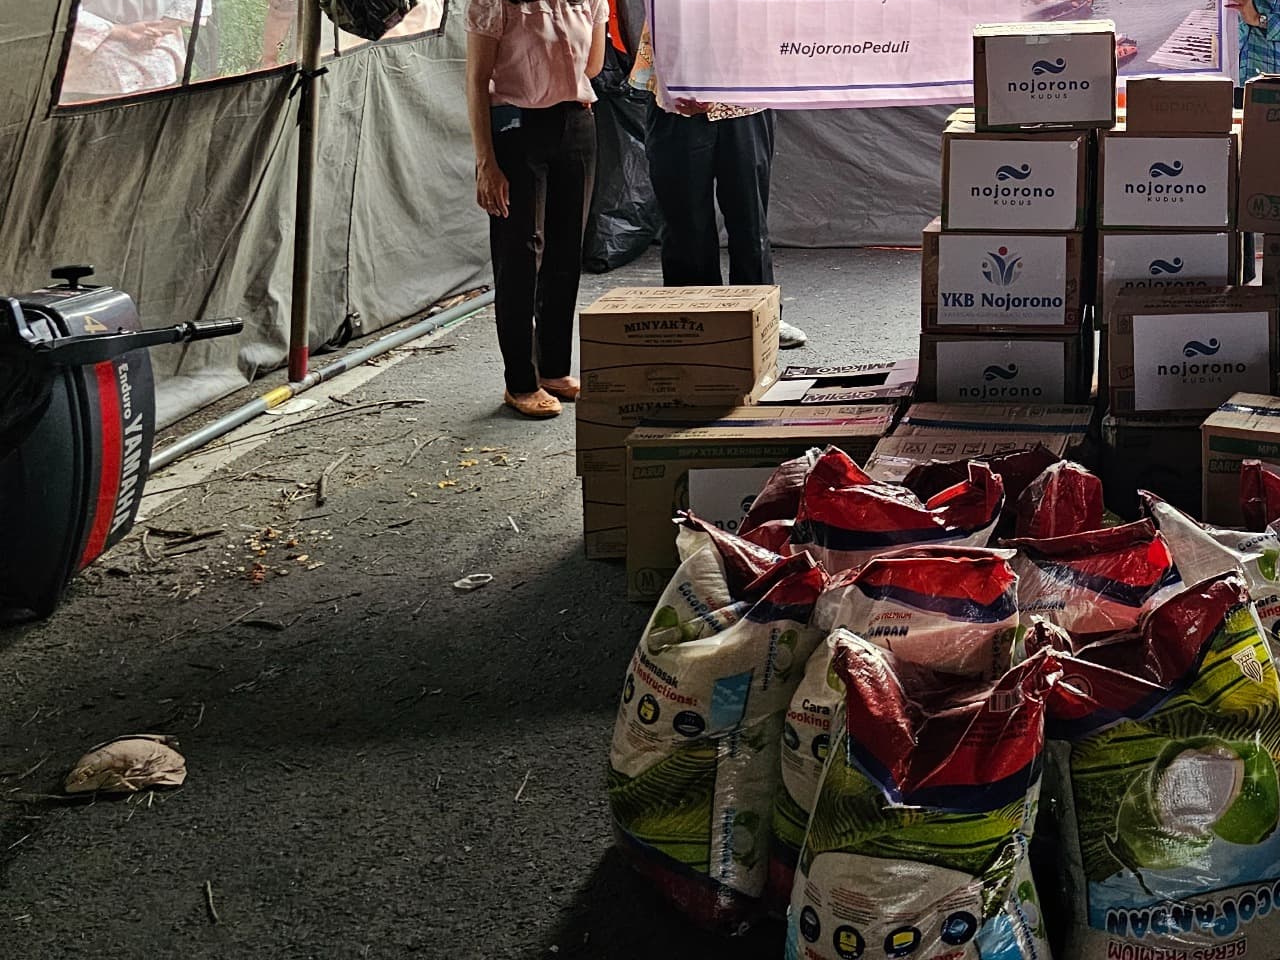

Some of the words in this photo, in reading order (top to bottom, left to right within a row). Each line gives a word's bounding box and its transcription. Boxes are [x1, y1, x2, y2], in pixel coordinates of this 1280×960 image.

[779, 40, 909, 57] #NojoronoPeduli
[1008, 77, 1090, 94] nojorono
[971, 183, 1055, 199] nojorono
[1125, 180, 1206, 195] nojorono
[941, 292, 975, 308] YKB
[981, 293, 1063, 311] Nojorono
[1157, 361, 1246, 376] nojorono
[116, 362, 132, 420] Enduro
[959, 385, 1042, 399] nojorono
[1257, 444, 1278, 456] MPP
[110, 411, 145, 534] YAMAHA
[802, 698, 830, 715] Cara
[1192, 937, 1247, 960] BERAS
